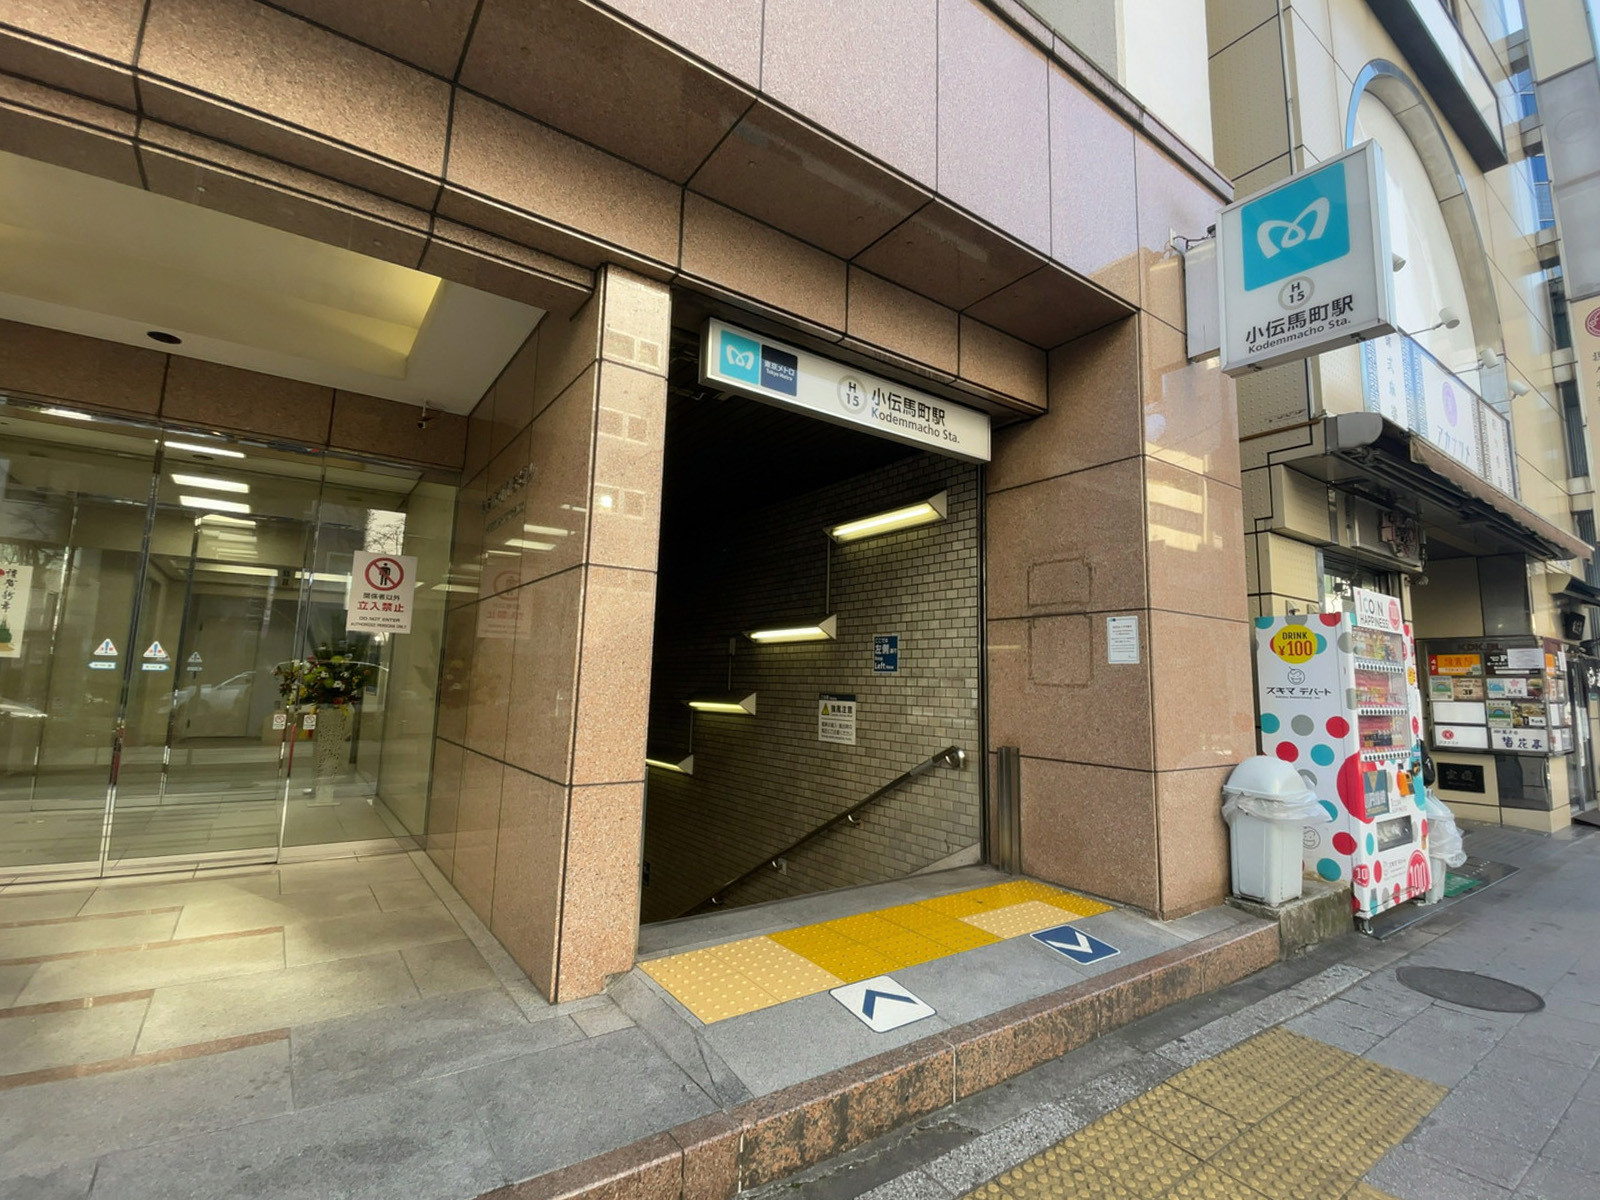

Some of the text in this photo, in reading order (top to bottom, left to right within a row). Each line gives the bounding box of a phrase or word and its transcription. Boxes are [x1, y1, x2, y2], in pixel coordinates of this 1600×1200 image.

[1291, 282, 1300, 292] H
[1289, 292, 1305, 304] 15
[1246, 294, 1354, 344] 小伝馬町駅
[1249, 318, 1351, 354] Kodemmacho Sta.
[764, 360, 795, 377] 東京メトロ
[848, 381, 857, 393] H
[846, 392, 860, 408] 15
[871, 387, 946, 427] 小伝馬町駅
[871, 406, 960, 444] Kodemmacho Sta.
[357, 602, 404, 612] 立入禁止
[1282, 631, 1308, 640] DRINK
[1278, 640, 1313, 657] ¥100
[1266, 686, 1295, 695] スキマ
